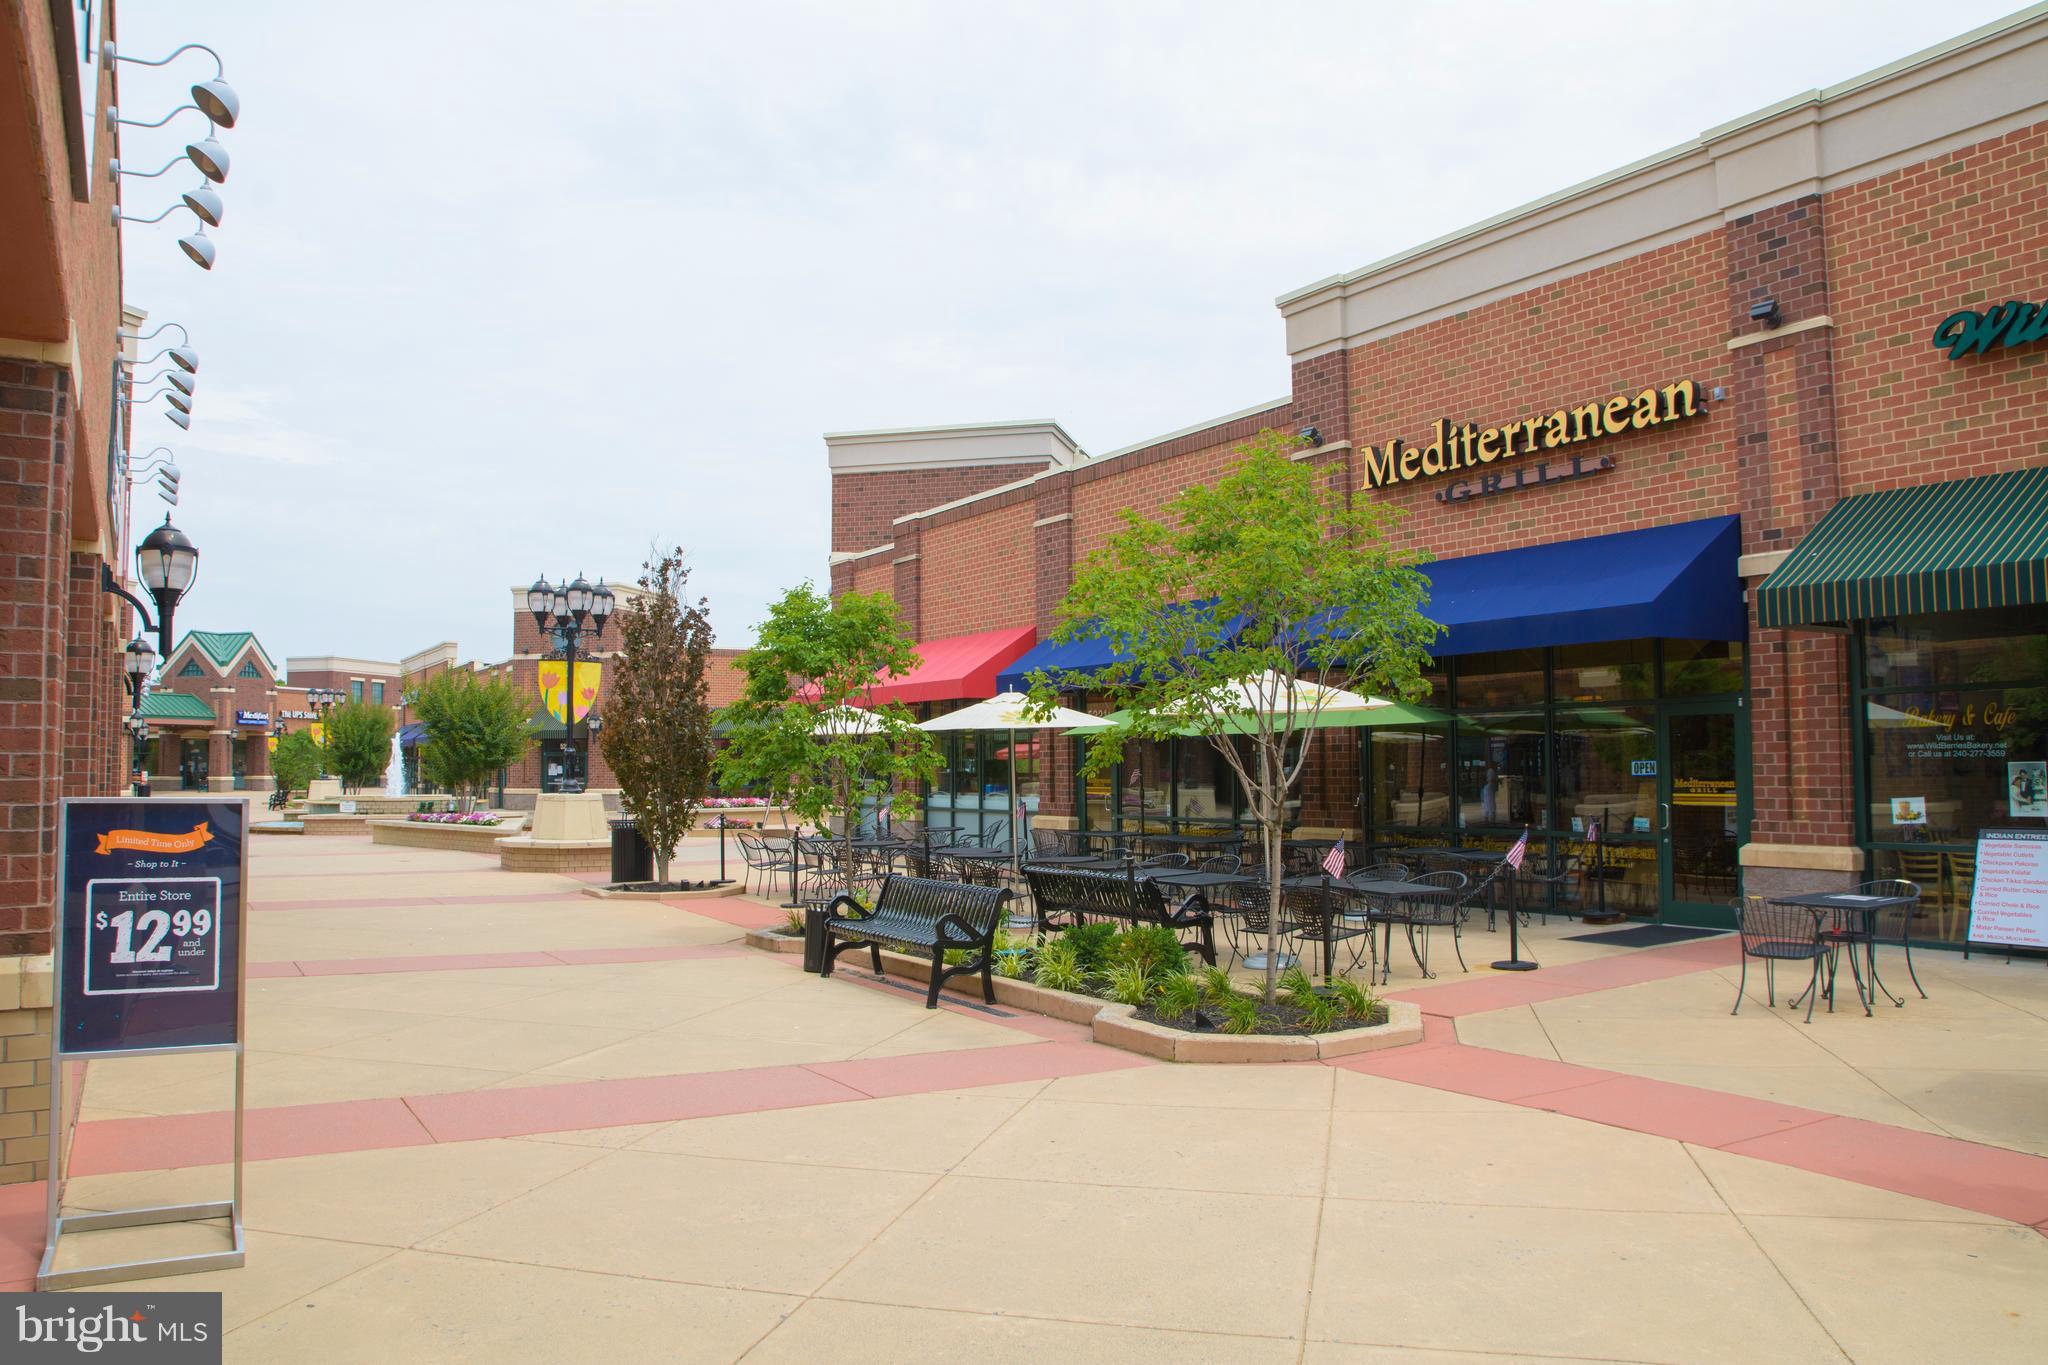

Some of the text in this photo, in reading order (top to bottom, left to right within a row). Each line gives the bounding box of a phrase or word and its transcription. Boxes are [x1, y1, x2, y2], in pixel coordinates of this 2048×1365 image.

[1360, 379, 1702, 491] Mediterranean
[1445, 454, 1597, 505] GRILL
[243, 711, 269, 720] Medifast
[282, 710, 292, 718] The
[1903, 706, 1955, 732] Bakery
[1962, 704, 1976, 725] &
[1634, 762, 1656, 774] OPEN
[1674, 778, 1735, 788] Mediterranean
[116, 835, 195, 848] Limited Time Only
[135, 860, 179, 869] Shop to It
[120, 889, 191, 901] Entire Store
[183, 937, 201, 947] and
[178, 947, 206, 957] under
